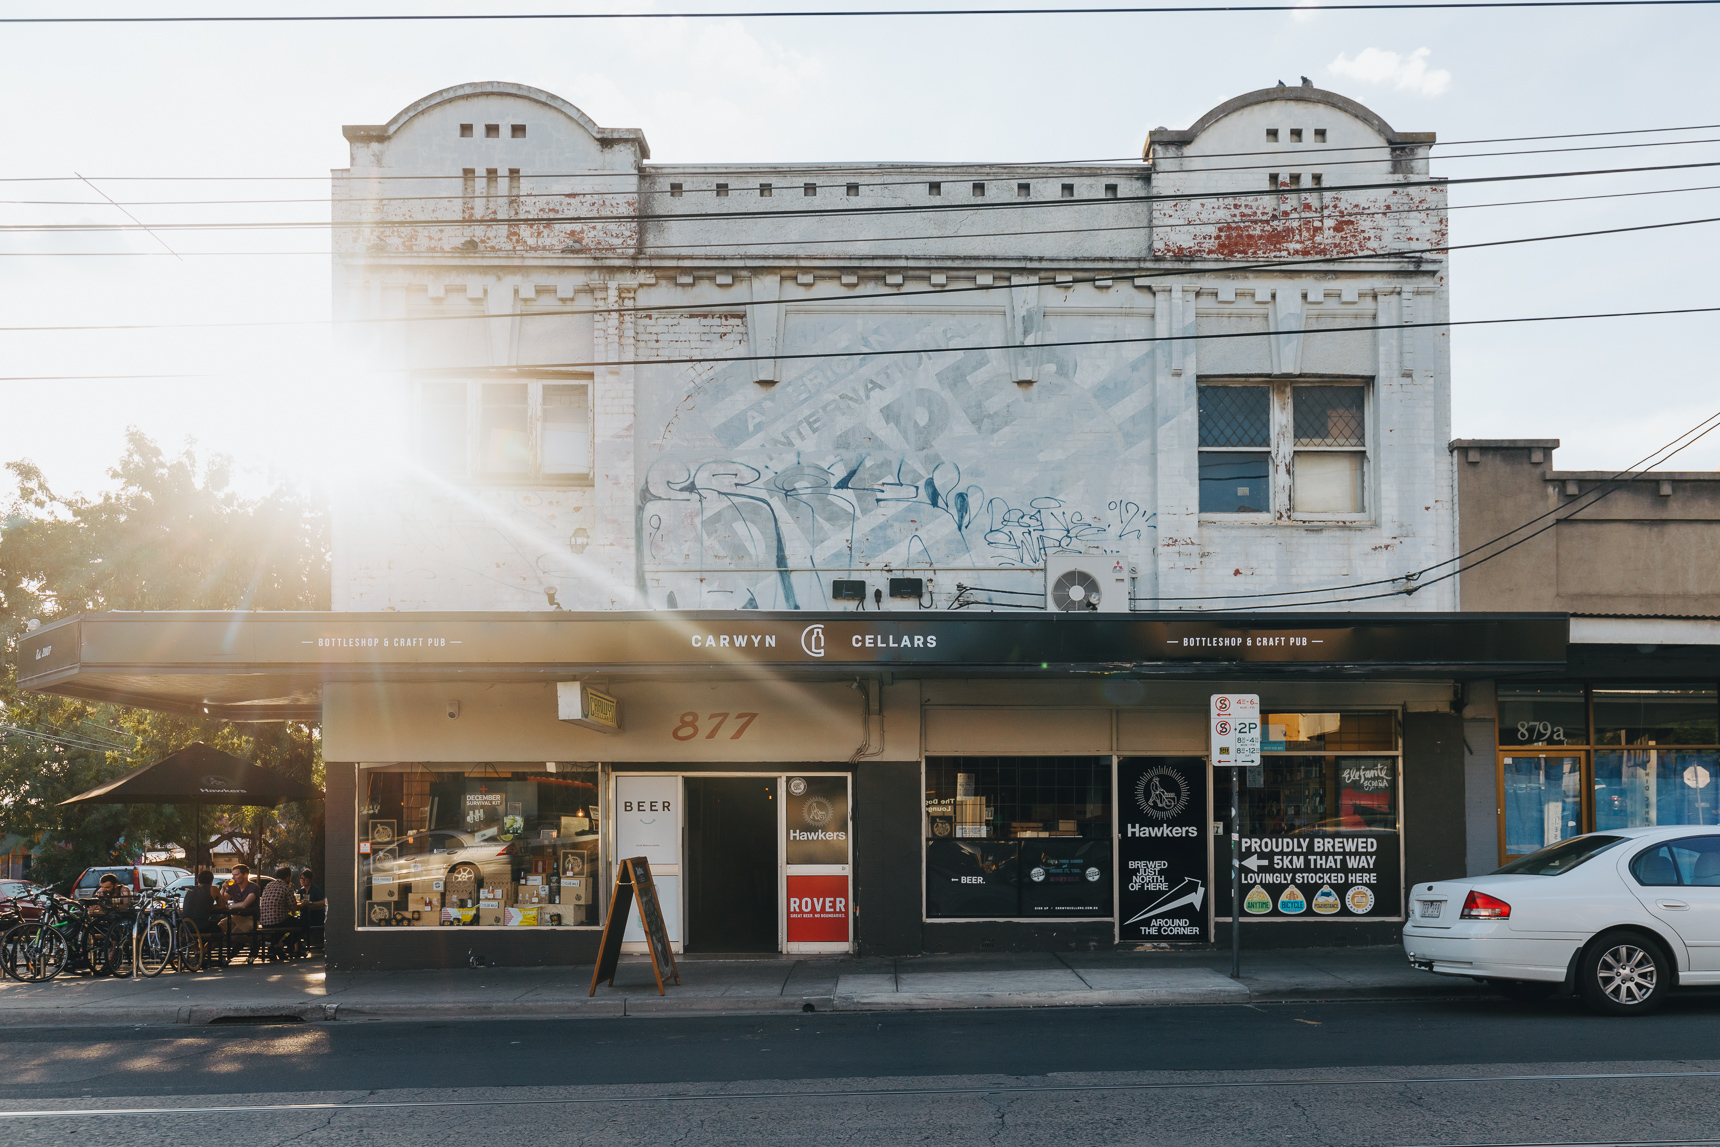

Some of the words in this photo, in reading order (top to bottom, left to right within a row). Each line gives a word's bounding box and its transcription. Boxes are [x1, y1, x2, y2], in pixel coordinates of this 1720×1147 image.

[318, 637, 379, 647] BOTTLESHOP
[383, 638, 389, 647] &
[393, 637, 424, 647] CRAFT
[428, 637, 446, 647] PUB
[691, 634, 776, 648] CARWYN
[851, 635, 937, 648] CELLARS
[1183, 637, 1242, 647] BOTTLESHOP
[1246, 638, 1252, 647] &
[1256, 637, 1285, 647] CRAFT
[1289, 637, 1308, 646] PUB
[671, 711, 759, 741] 877
[1238, 722, 1258, 734] 2P
[1517, 721, 1566, 742] 879a
[623, 800, 672, 812] BEER
[789, 829, 846, 841] Hawkers
[1127, 823, 1198, 838] Hawkers
[1241, 838, 1309, 852] PROUDLY
[1313, 838, 1377, 852] BREWED
[1128, 861, 1168, 869] BREWED
[1273, 855, 1305, 869] 5KM
[1308, 855, 1343, 869] THAT
[1345, 855, 1377, 869] WAY
[1136, 868, 1160, 876] JUST
[961, 876, 986, 884] BEER.
[1132, 875, 1165, 884] NORTH
[1241, 873, 1293, 884] LOVINGLY
[1295, 873, 1345, 884] STOCKED
[1348, 873, 1377, 884] HERE
[1128, 882, 1143, 891] OF
[1144, 882, 1169, 891] HERE
[790, 897, 846, 912] ROVER
[1247, 901, 1270, 909] ANYTIME
[1281, 900, 1304, 909] BICYCLE
[1150, 918, 1190, 927] AROUND
[1140, 926, 1158, 935] THE
[1161, 926, 1200, 935] CORNER
